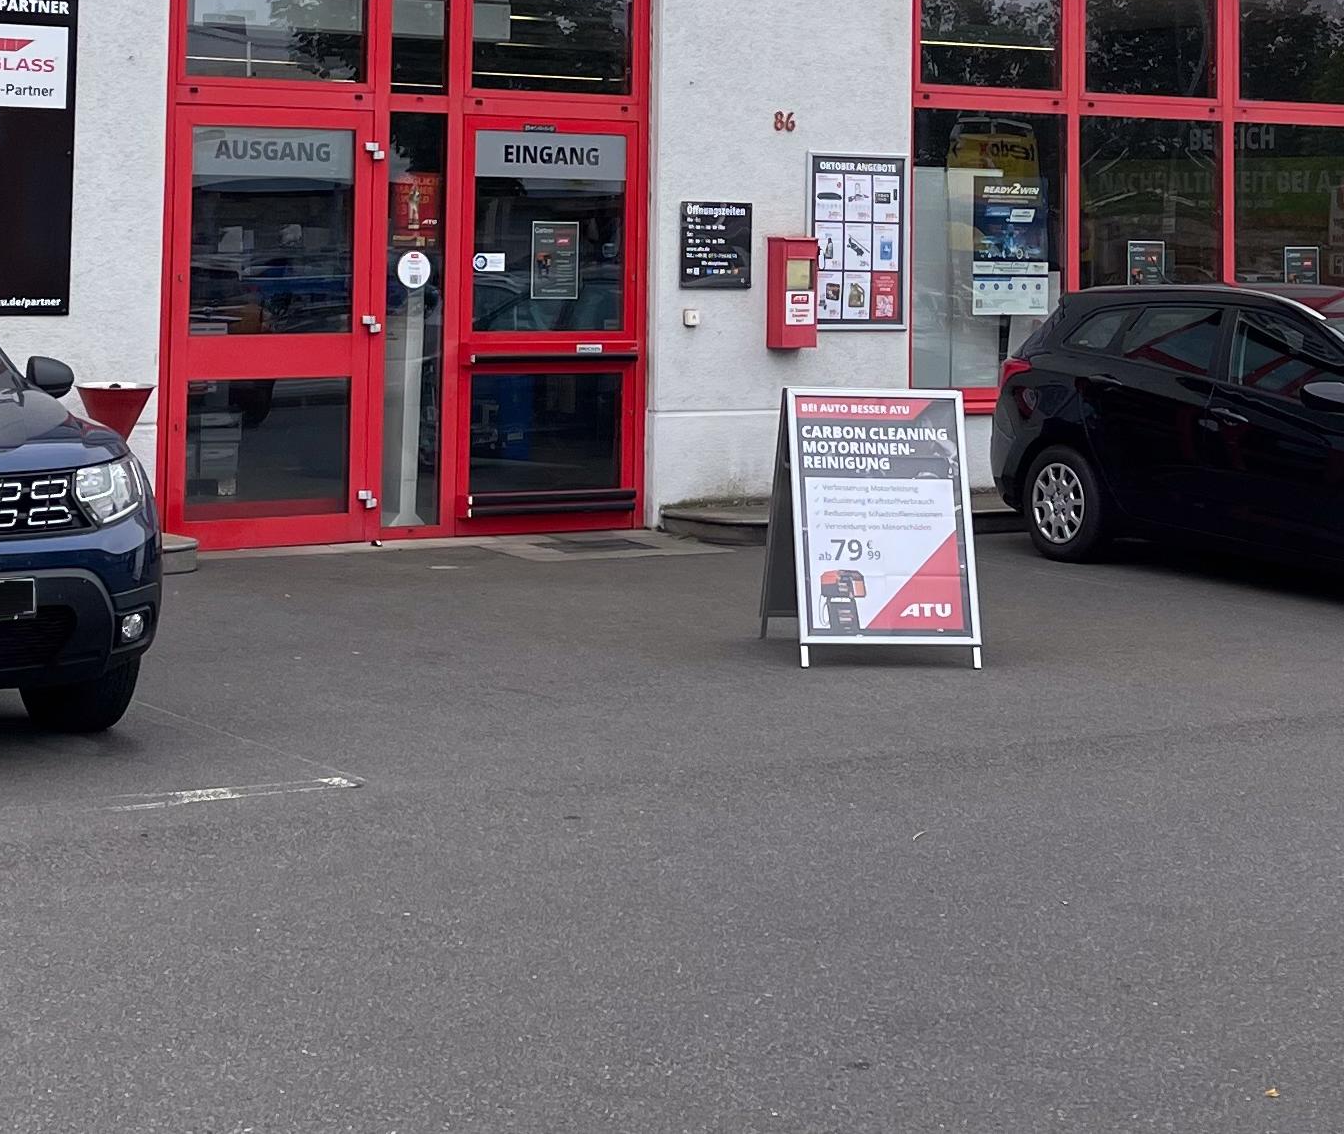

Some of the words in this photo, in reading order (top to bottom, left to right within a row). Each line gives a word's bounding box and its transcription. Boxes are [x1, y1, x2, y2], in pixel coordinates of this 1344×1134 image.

[774, 110, 796, 132] 86
[214, 139, 332, 163] AUSGANG
[504, 144, 600, 166] EINGANG
[819, 161, 855, 172] OKTOBER
[856, 162, 897, 173] ANGEBOTE
[686, 202, 746, 218] Öffnungszeiten
[801, 403, 817, 413] BEI
[820, 404, 848, 414] AUTO
[851, 404, 887, 415] BESSER
[890, 405, 910, 415] ATU
[801, 425, 866, 440] CARBON
[869, 427, 948, 442] CLEANING
[802, 441, 916, 456] MOTORINNEN-
[803, 456, 891, 471] REINIGUNG
[818, 551, 832, 562] ab
[830, 538, 864, 562] 79
[867, 550, 881, 561] 99
[900, 602, 952, 618] ATU
